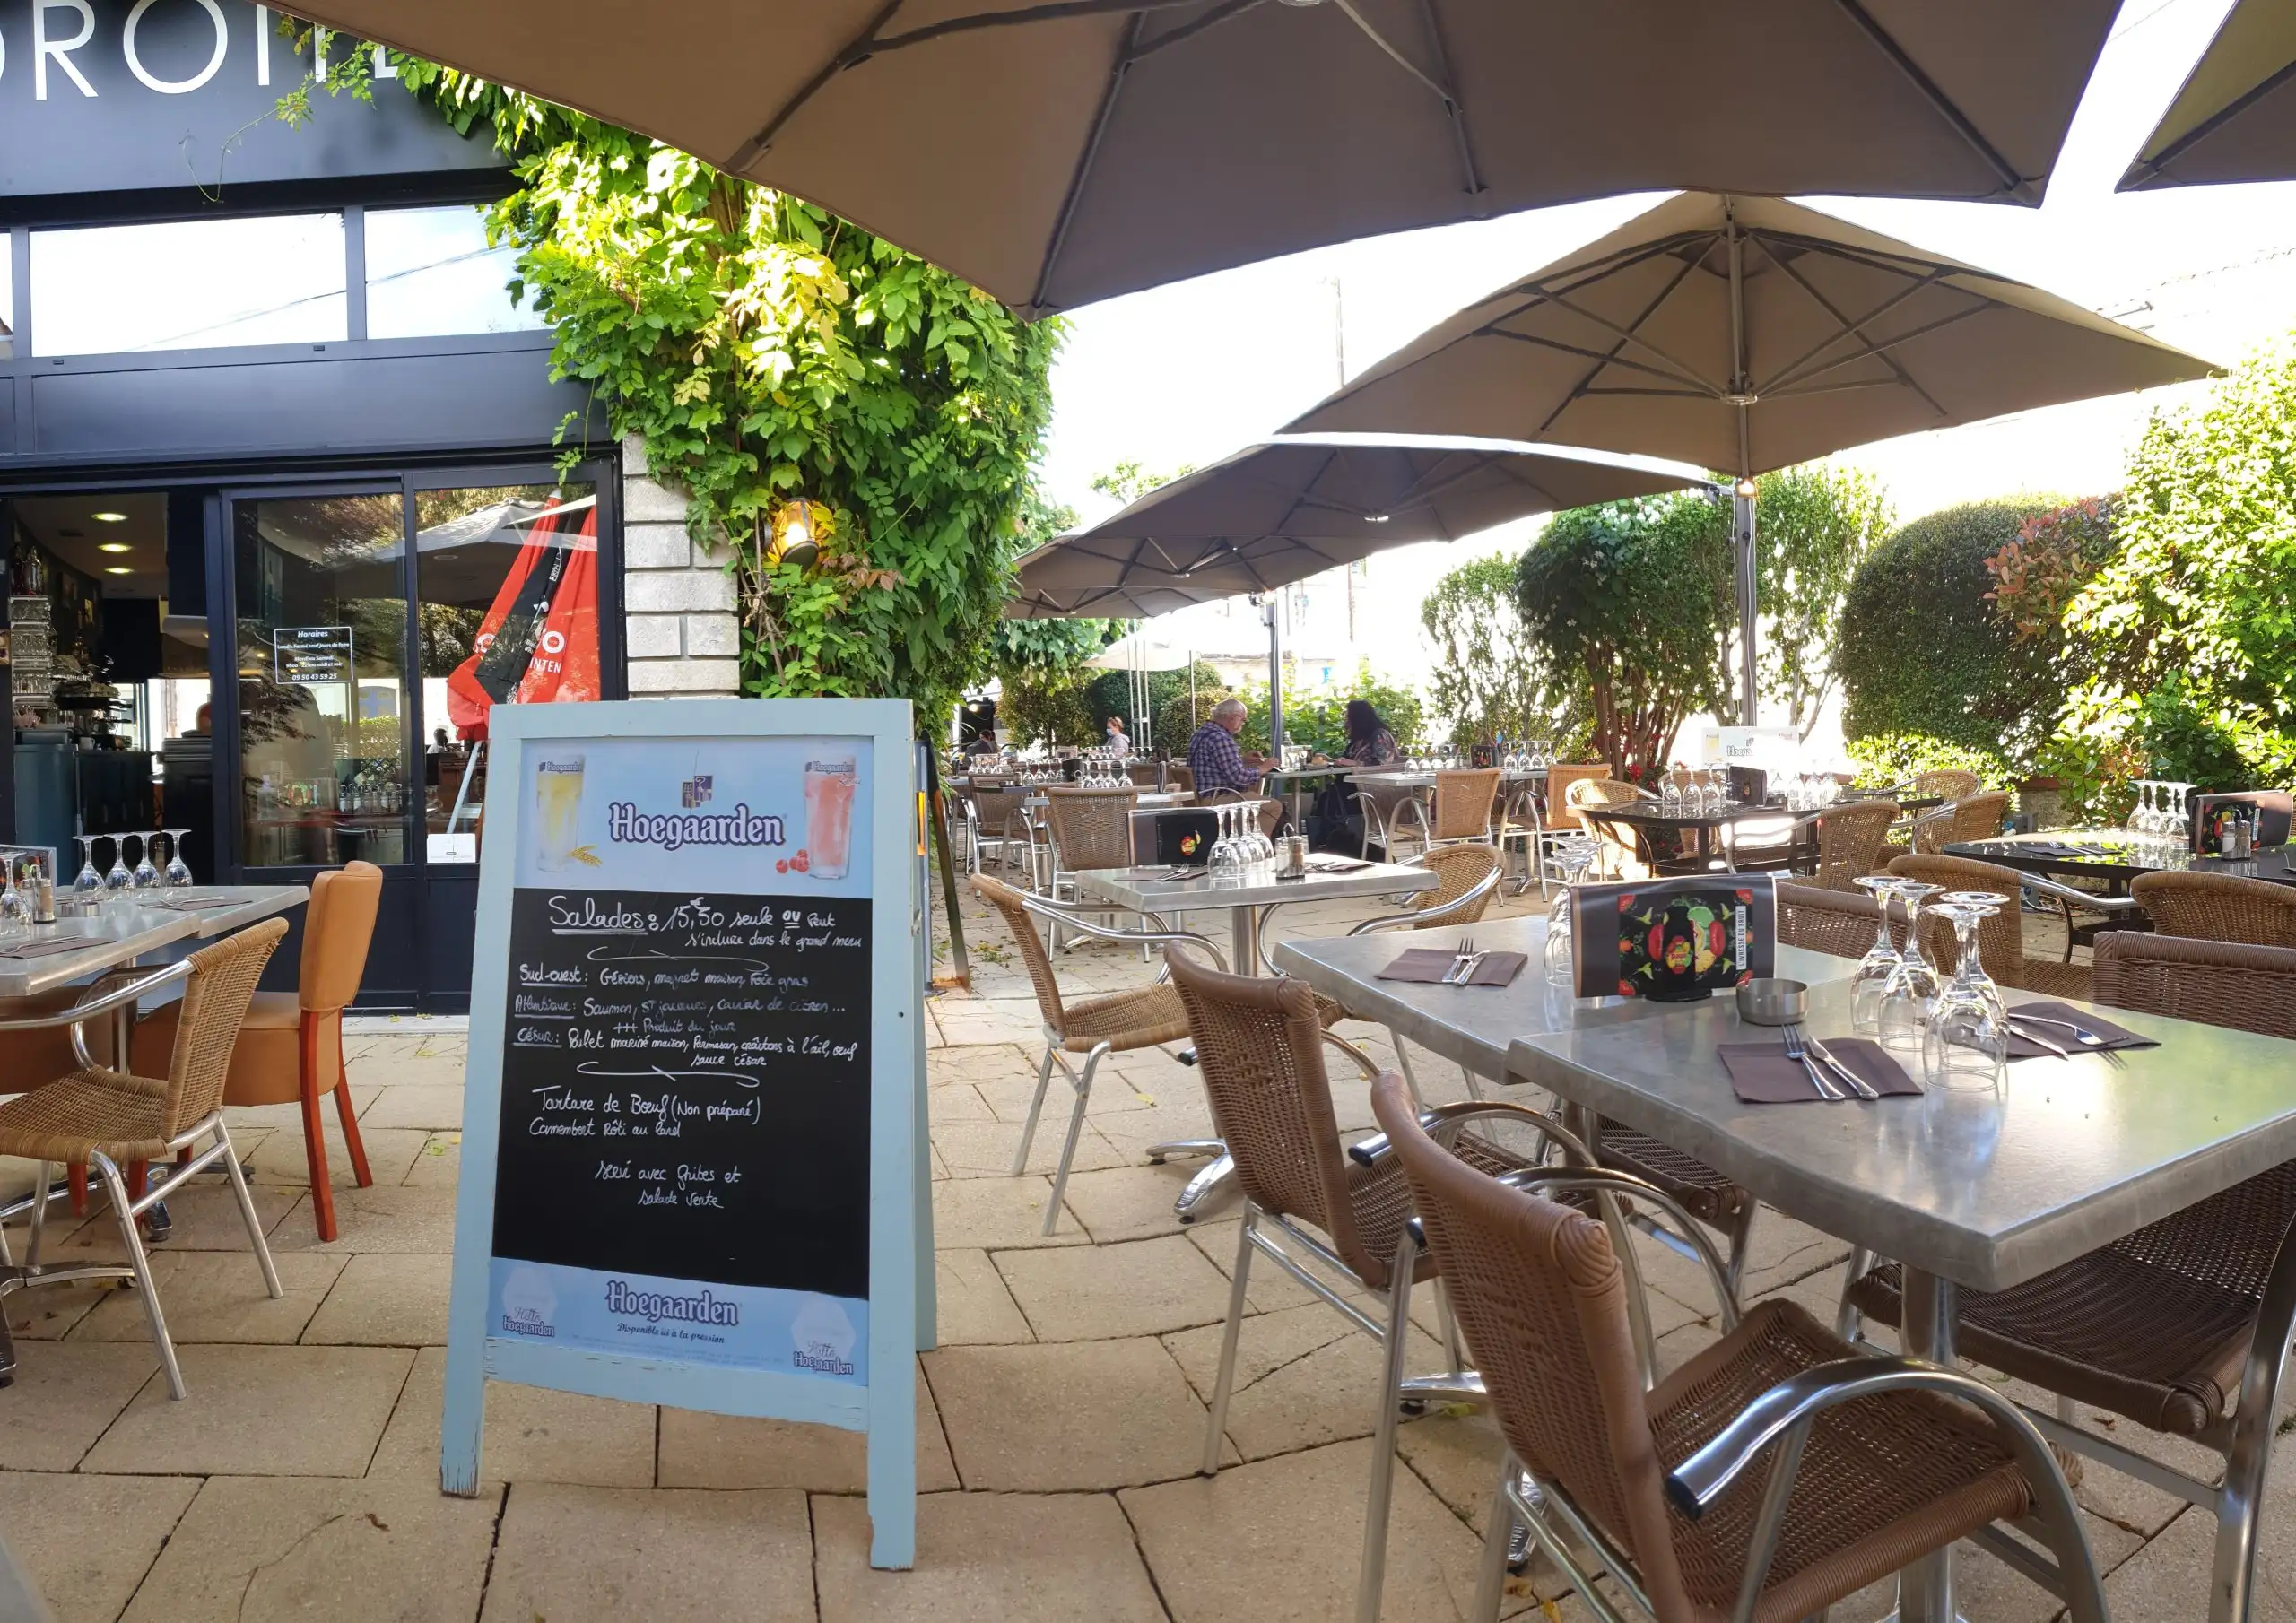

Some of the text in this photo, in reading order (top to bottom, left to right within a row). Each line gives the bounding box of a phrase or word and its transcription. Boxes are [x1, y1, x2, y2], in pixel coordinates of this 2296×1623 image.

[609, 802, 786, 851] Hoegaarden
[728, 906, 774, 928] seule
[749, 930, 775, 946] dans
[780, 931, 790, 946] le
[796, 931, 832, 952] grand
[832, 936, 861, 947] menu
[778, 977, 809, 994] gras
[767, 996, 786, 1011] de
[643, 1017, 683, 1032] Produit
[687, 1020, 704, 1032] du
[709, 1020, 736, 1038] jour
[568, 1028, 605, 1049] Poulet
[787, 1037, 796, 1053] à
[691, 1055, 726, 1067] sauce
[532, 1085, 596, 1112] Tartare
[603, 1093, 622, 1113] de
[529, 1117, 596, 1136] Camembert
[631, 1126, 648, 1135] au
[655, 1121, 681, 1137] lard
[638, 1167, 667, 1181] avec
[677, 1164, 715, 1190] frites
[724, 1166, 742, 1183] et
[604, 1280, 739, 1326] Hoegaarden
[617, 1322, 726, 1344] Disponible ici à la pression
